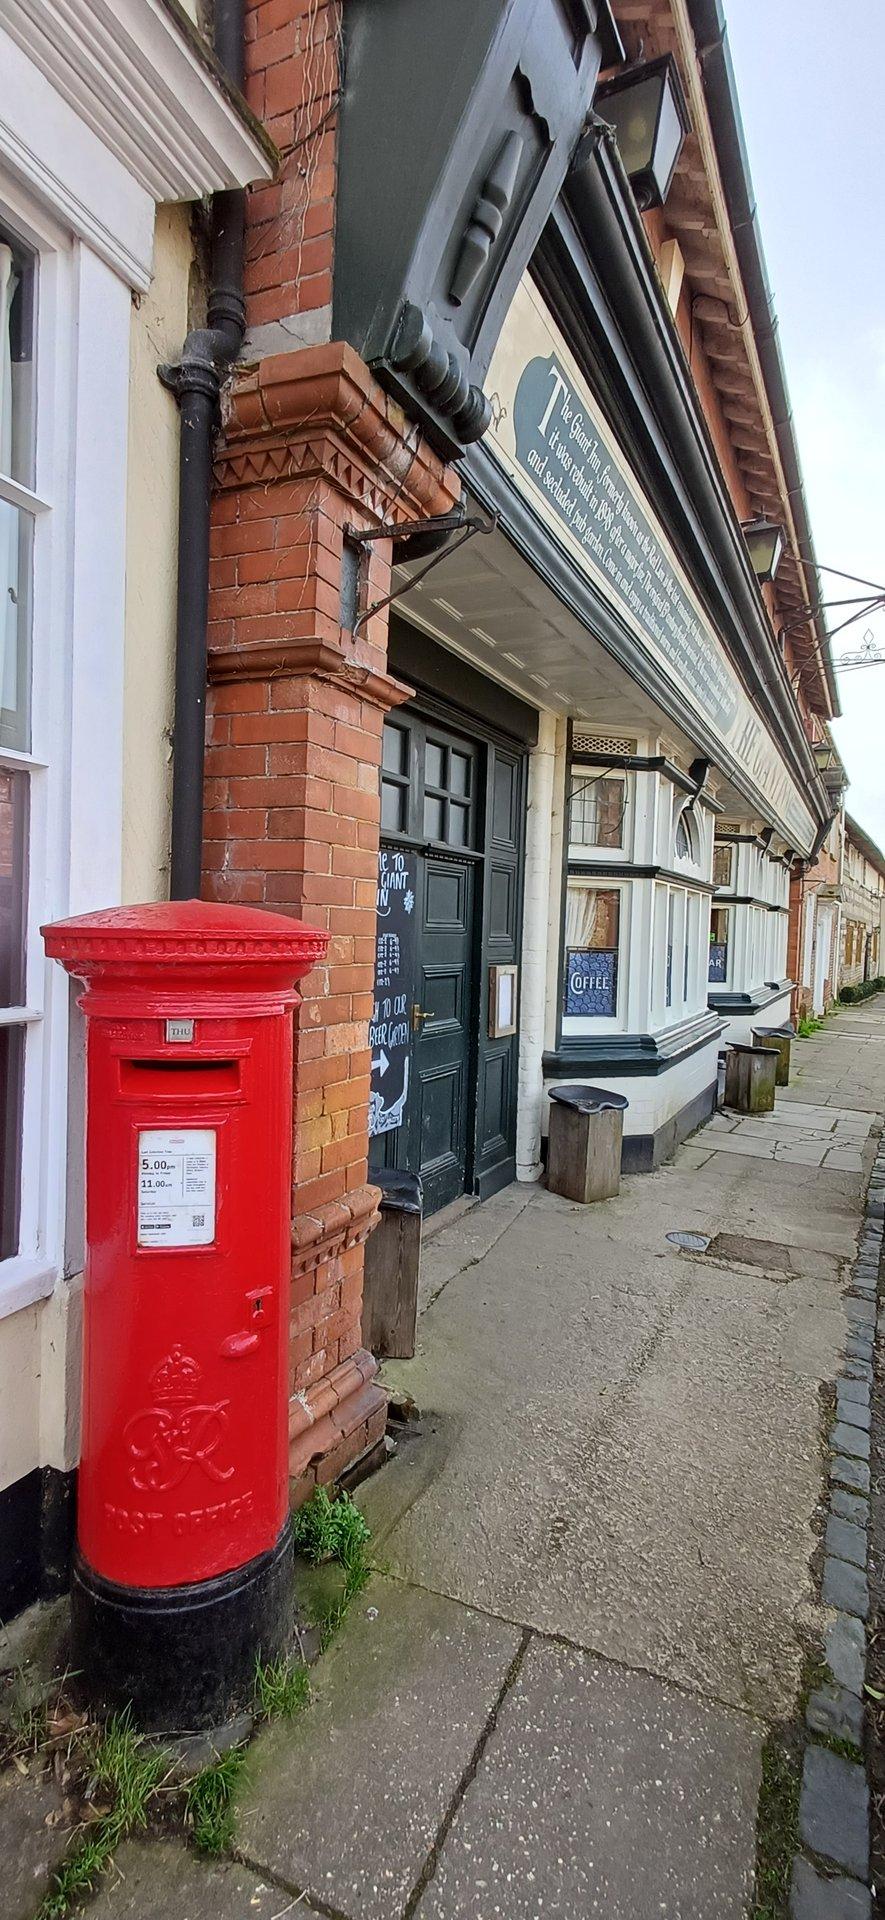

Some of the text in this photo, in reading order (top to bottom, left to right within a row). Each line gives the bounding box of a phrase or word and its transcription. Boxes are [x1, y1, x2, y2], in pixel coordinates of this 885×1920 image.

[537, 365, 573, 437] The
[569, 413, 593, 455] Giant
[596, 465, 625, 515] formerly
[621, 500, 638, 537] known
[635, 531, 644, 546] as
[548, 426, 560, 450] it
[555, 442, 573, 471] was
[569, 464, 594, 502] rebuilt
[588, 491, 599, 513] in
[594, 499, 615, 532] 1898
[608, 525, 624, 549] after
[620, 541, 627, 556] a
[527, 449, 549, 478] and
[543, 471, 577, 517] secluded
[568, 508, 587, 533] pub
[614, 566, 622, 585] in
[380, 871, 409, 890] GIANT
[708, 958, 722, 968] AR
[570, 971, 610, 995] COFFEE
[394, 993, 407, 1016] OUR
[170, 1027, 191, 1037] THU
[369, 1022, 387, 1049] BEER
[142, 1159, 176, 1170] 5.00pm
[173, 1490, 255, 1536] OFFICE
